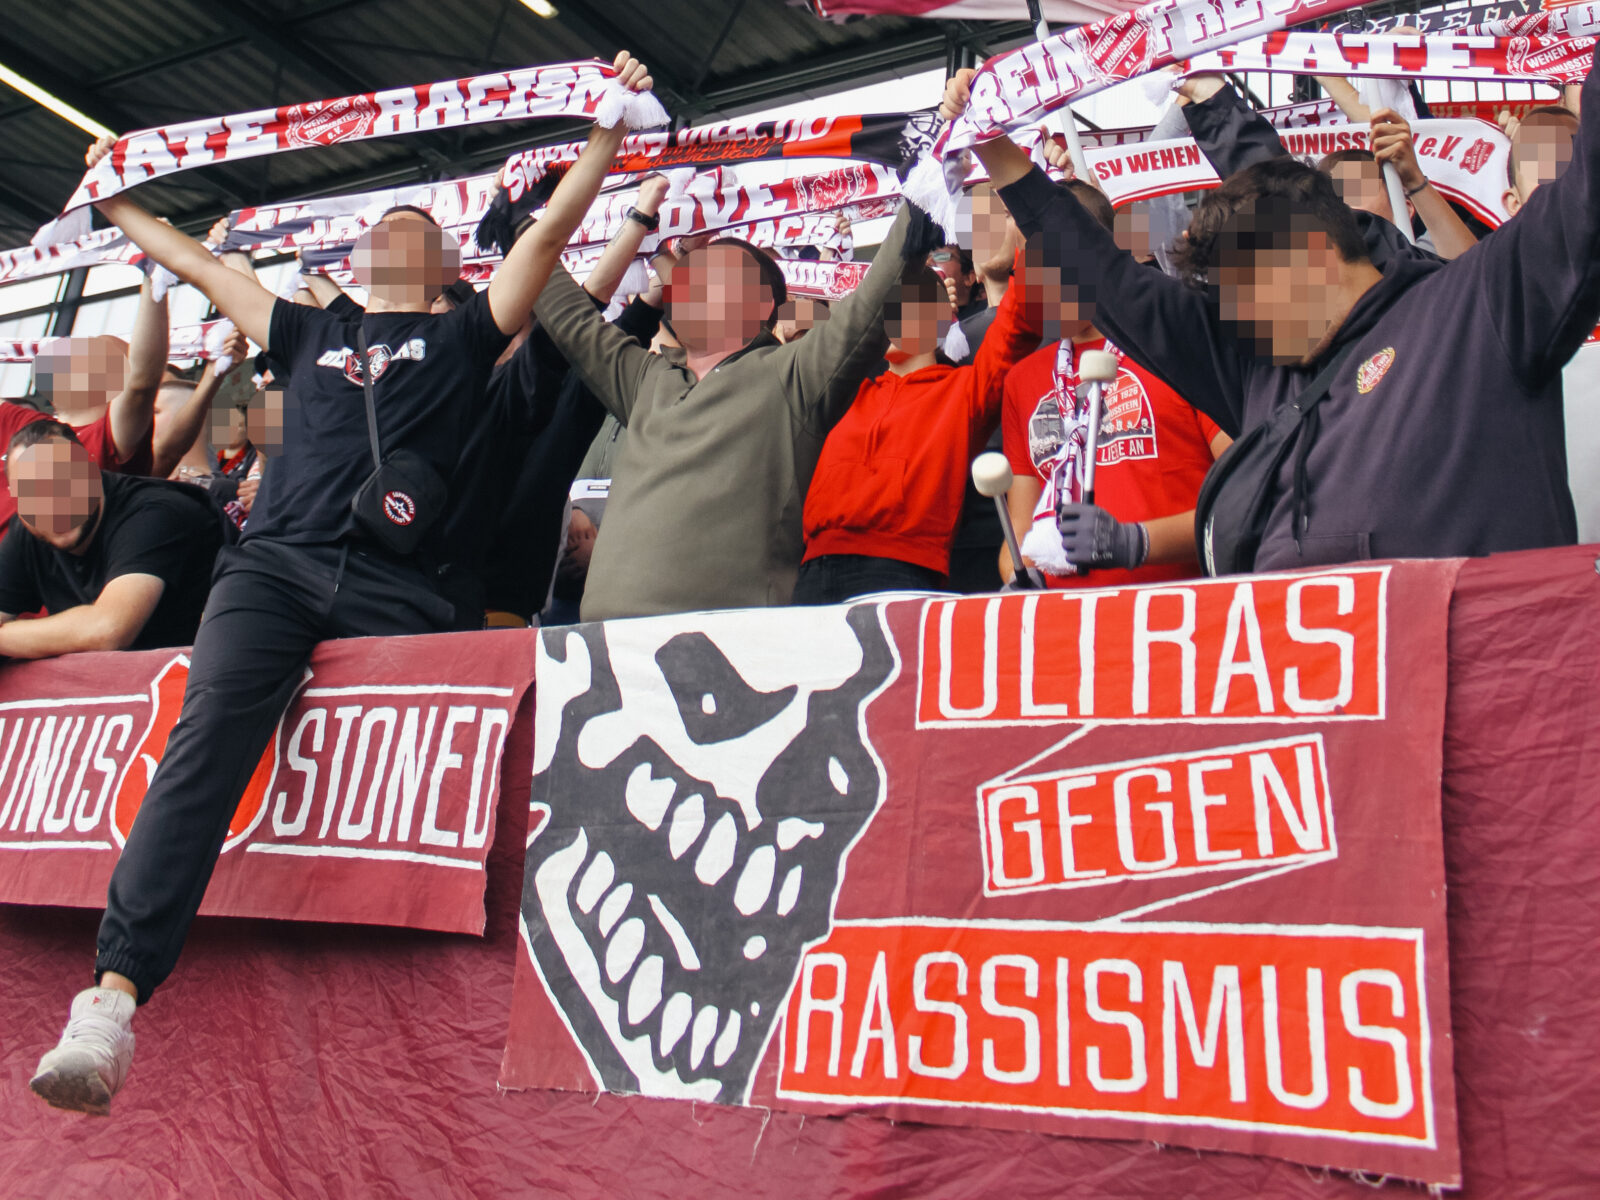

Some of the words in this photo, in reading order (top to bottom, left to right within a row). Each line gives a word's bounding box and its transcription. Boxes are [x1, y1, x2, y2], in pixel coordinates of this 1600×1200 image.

[1090, 19, 1105, 35] SV
[1092, 29, 1118, 60] WEHEN
[1102, 22, 1142, 71] TAUNUSSTEIN
[1526, 45, 1568, 69] WEHEN
[303, 111, 332, 129] WEHEN
[1094, 159, 1123, 181] SV
[1126, 144, 1201, 174] WEHEN
[1419, 135, 1463, 161] e.V.
[657, 176, 790, 237] OVE
[1129, 439, 1145, 455] AN
[938, 576, 1354, 719] ULTRAS
[272, 705, 510, 849] STONED
[987, 745, 1325, 889] GEGEN
[794, 950, 1414, 1120] RASSISMUS
